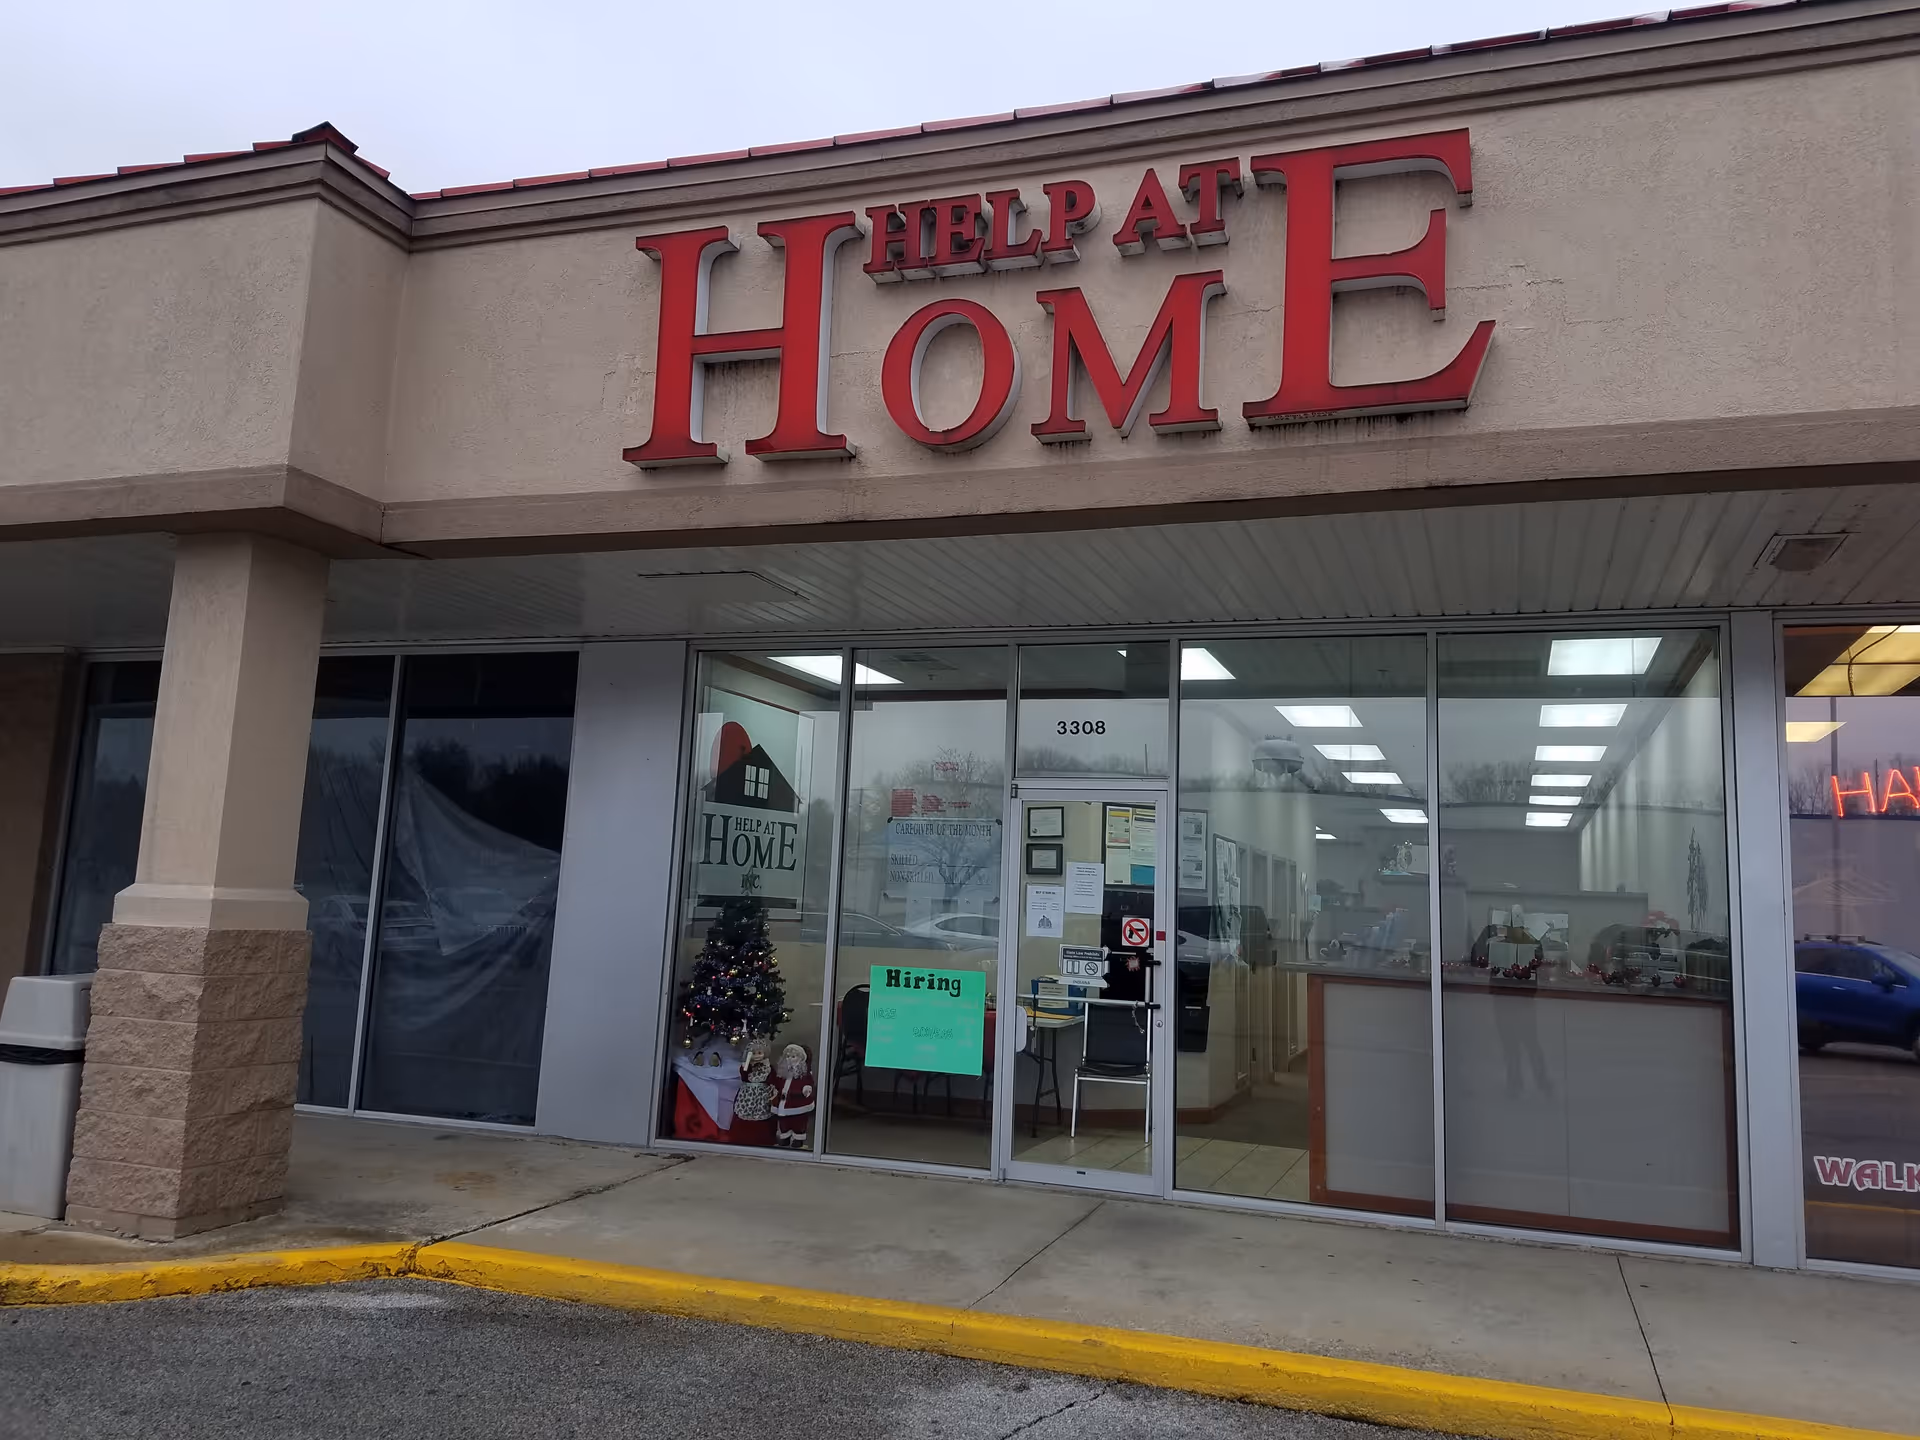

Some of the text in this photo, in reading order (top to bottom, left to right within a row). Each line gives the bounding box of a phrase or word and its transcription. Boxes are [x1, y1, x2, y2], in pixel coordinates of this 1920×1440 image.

[863, 159, 1243, 280] HELP AT
[622, 127, 1496, 468] HOME
[1056, 720, 1106, 735] 3308
[734, 816, 777, 835] HELP AT
[895, 822, 992, 837] CAREGIVER OF THE MONTH
[699, 813, 798, 871] HOME
[885, 969, 962, 997] Hiring
